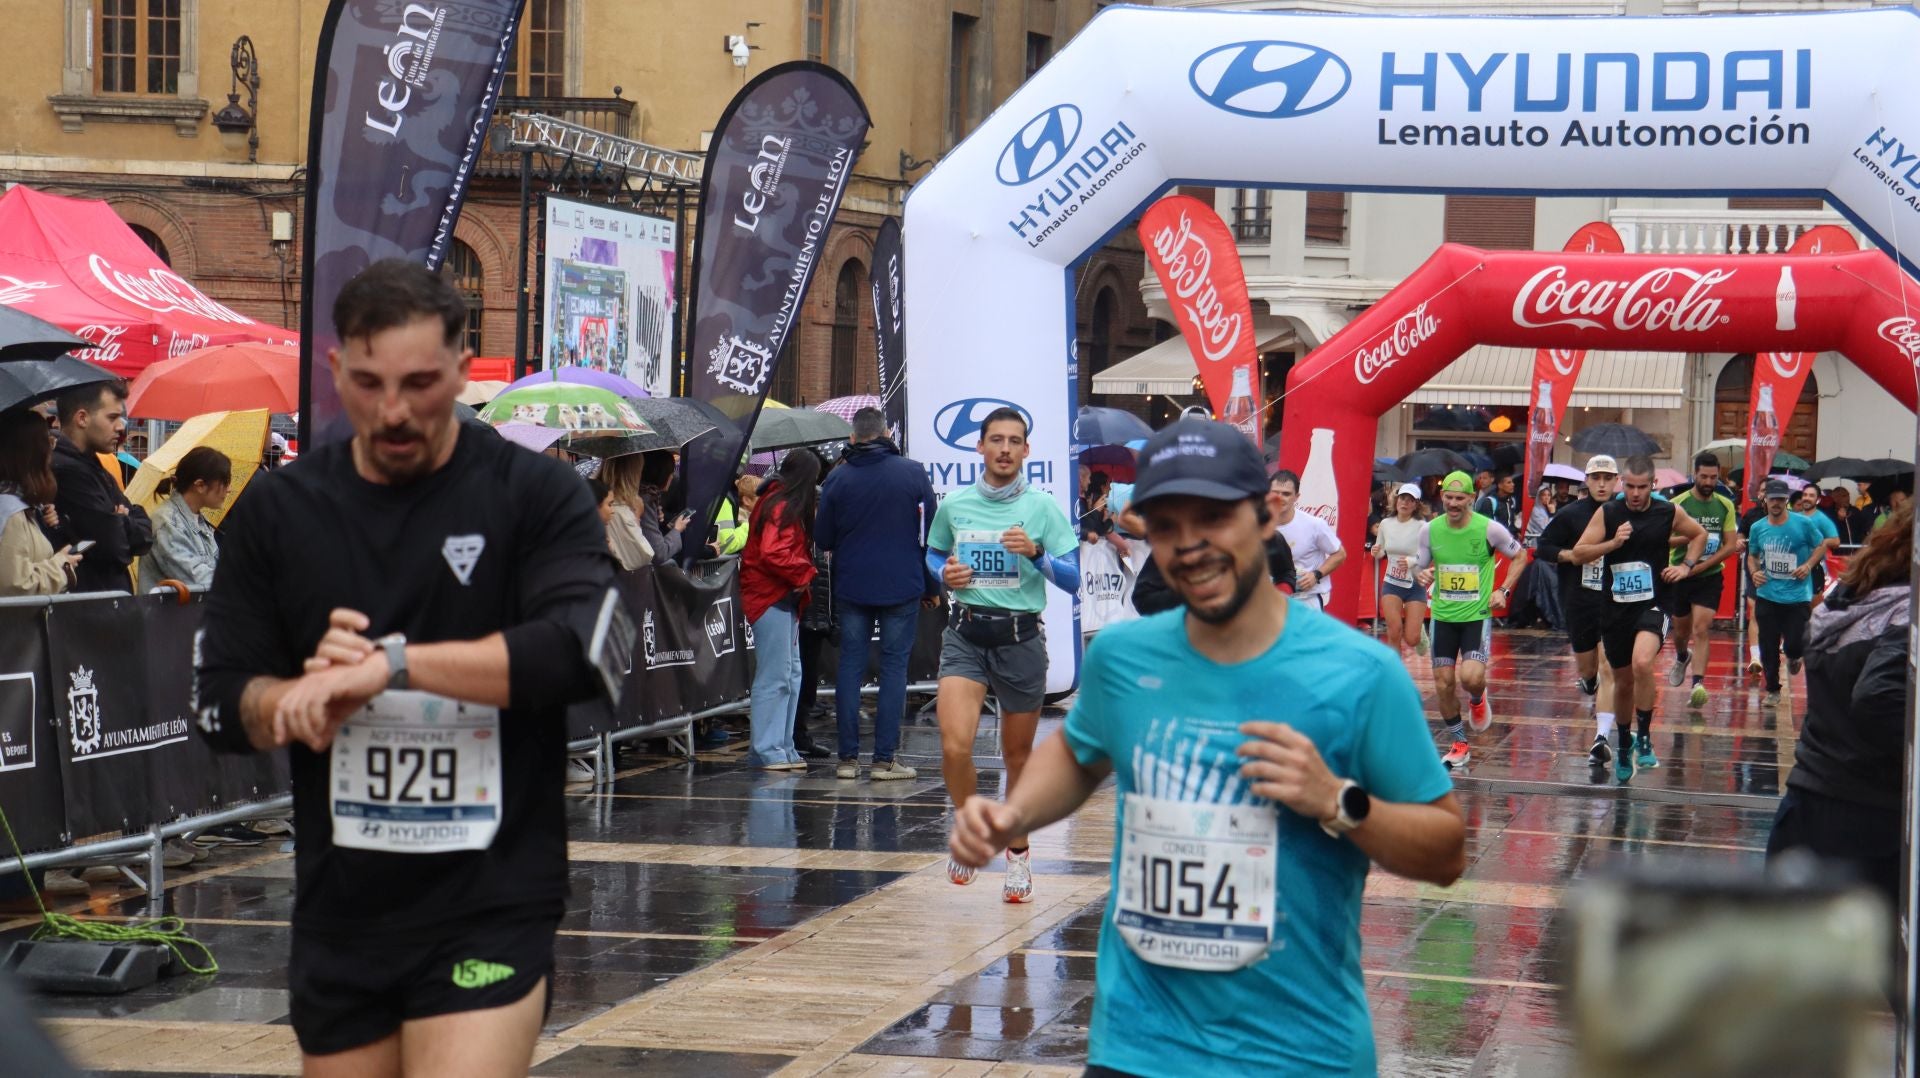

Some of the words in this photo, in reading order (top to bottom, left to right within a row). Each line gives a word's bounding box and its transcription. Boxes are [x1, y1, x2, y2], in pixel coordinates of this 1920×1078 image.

[405, 60, 418, 84] Cuna
[413, 43, 425, 58] del
[413, 8, 447, 88] Parlamentarismo
[1379, 48, 1812, 113] HYUNDAI
[1378, 117, 1550, 148] Lemauto
[1560, 113, 1812, 148] Automoción
[1008, 120, 1137, 239] HYUNDAI
[1028, 204, 1079, 248] Lemauto
[1079, 141, 1147, 205] Automoción
[1853, 147, 1905, 196] Lemauto
[769, 219, 822, 346] AYUNTAMIENTO
[815, 193, 832, 216] DE
[824, 146, 848, 190] LEÓN
[1512, 265, 1738, 332] Coca-Cola
[1354, 301, 1438, 385] Coca-Cola
[971, 550, 1005, 572] 366
[1450, 577, 1466, 591] 52
[1620, 575, 1643, 591] 645
[1771, 560, 1789, 573] 1198
[170, 714, 188, 735] LEÓN
[366, 746, 457, 803] 929
[388, 824, 470, 840] HYUNDAI
[1140, 854, 1239, 921] 1054
[1160, 938, 1240, 959] HYUNDAI
